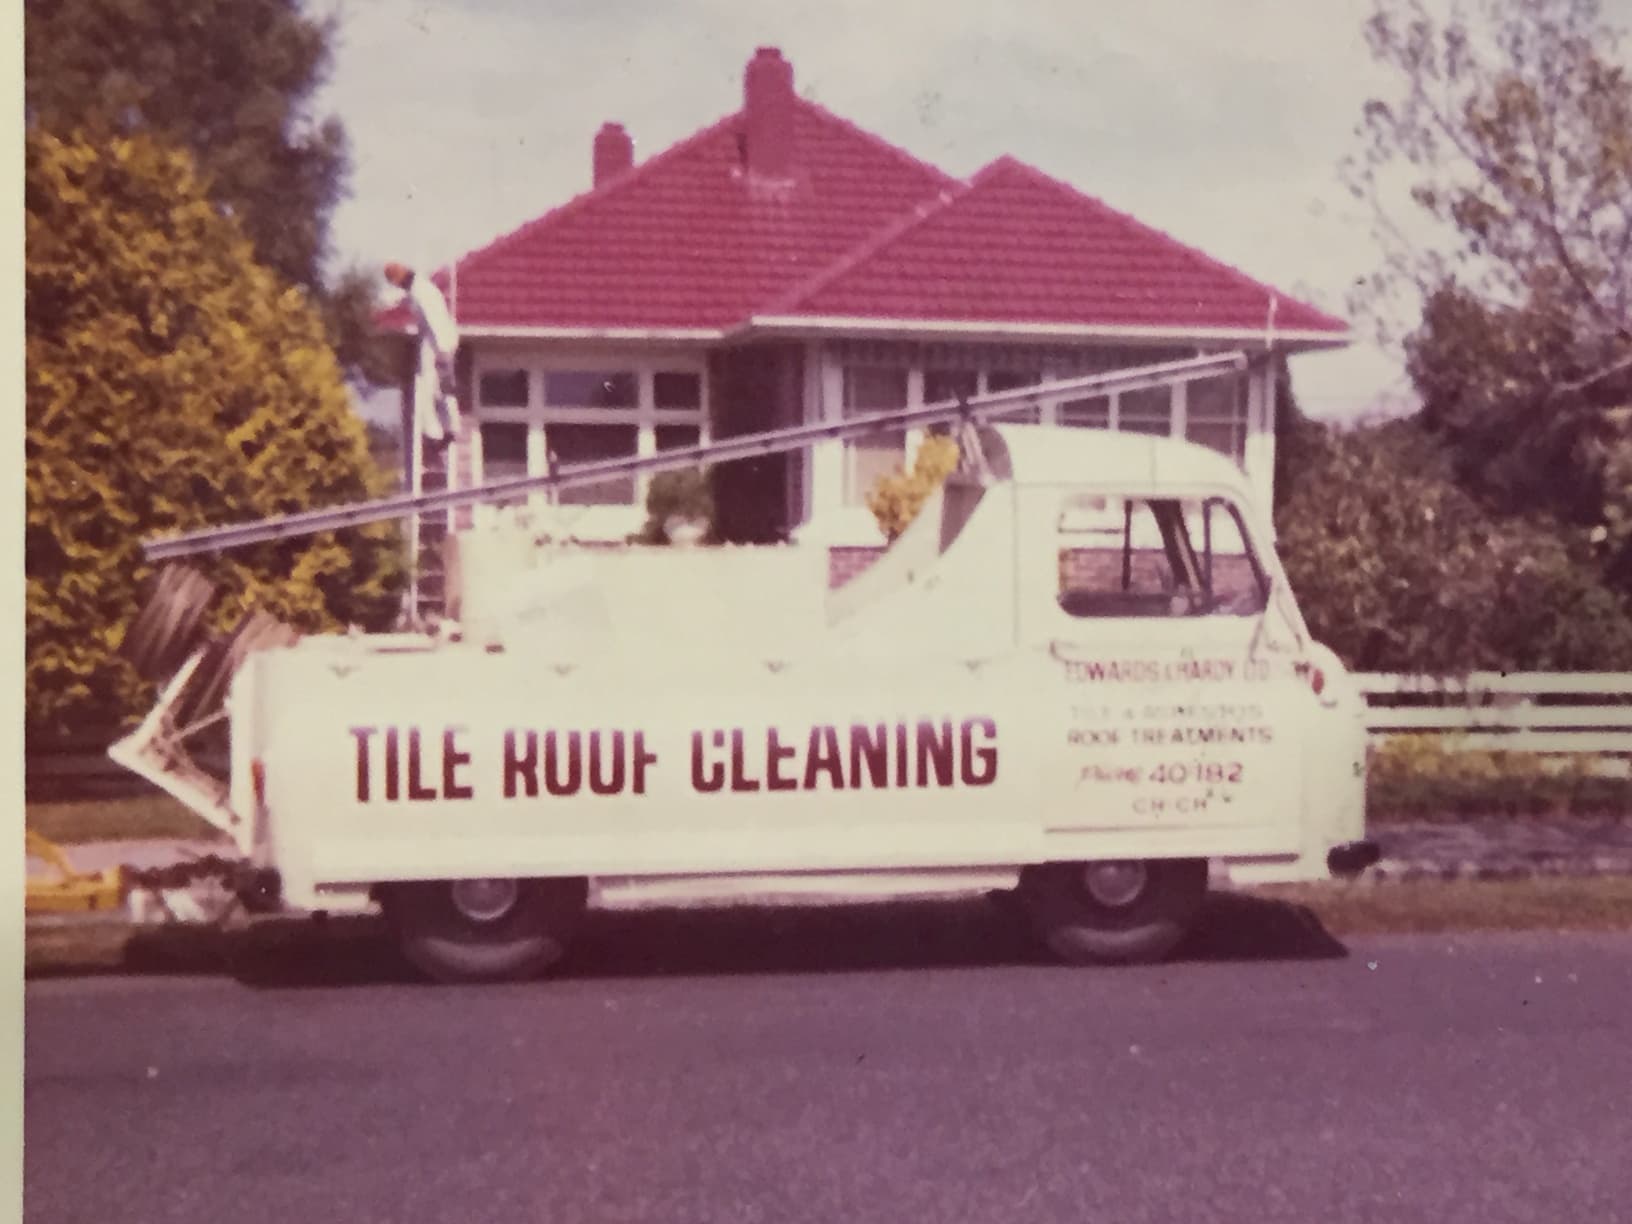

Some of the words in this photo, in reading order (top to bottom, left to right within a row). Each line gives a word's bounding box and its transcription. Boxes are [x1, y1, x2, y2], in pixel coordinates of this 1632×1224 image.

[348, 725, 473, 802] TILE
[691, 716, 998, 793] CLEANING
[1131, 726, 1273, 744] TREATMENTS
